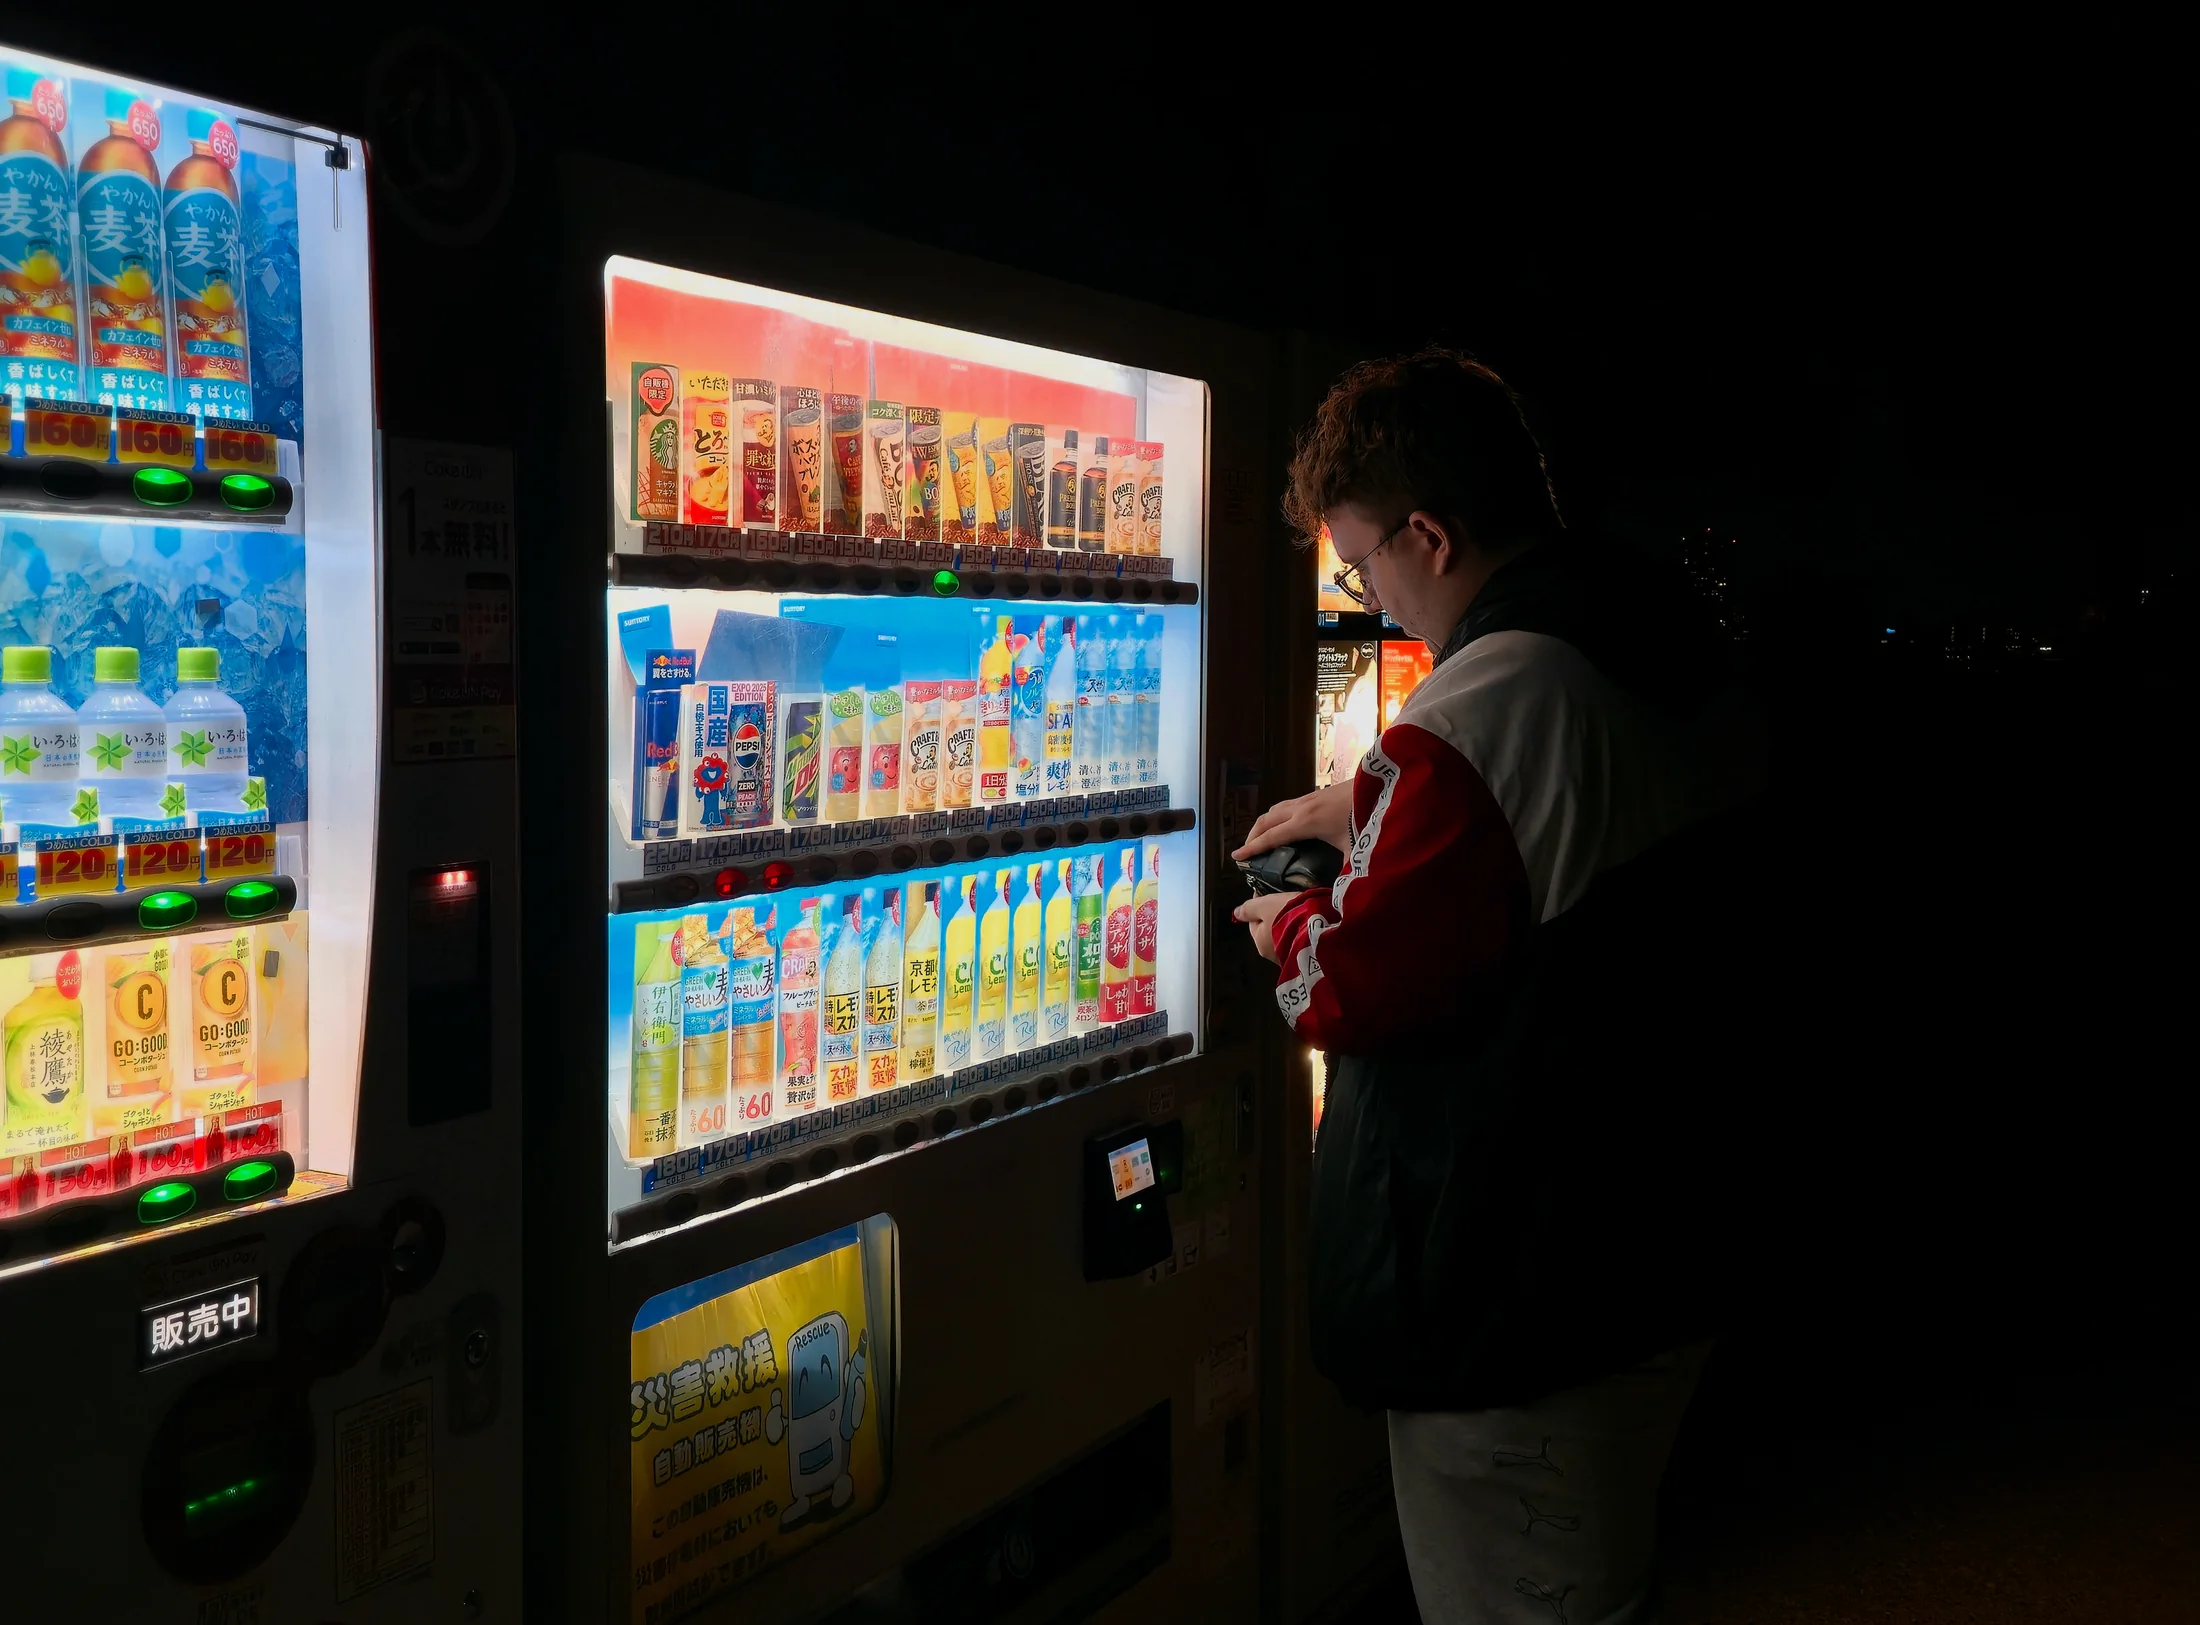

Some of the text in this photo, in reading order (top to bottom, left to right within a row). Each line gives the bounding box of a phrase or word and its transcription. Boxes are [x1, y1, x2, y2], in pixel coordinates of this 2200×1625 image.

[36, 98, 66, 120] 650
[132, 117, 158, 140] 650
[213, 135, 237, 157] 650
[3, 167, 60, 190] やかん
[100, 185, 153, 207] やかん
[0, 187, 70, 246] 麦茶
[185, 203, 231, 224] やかん
[85, 205, 160, 262] 麦茶
[173, 224, 240, 278] 麦茶
[12, 318, 72, 336] カフェインゼロ
[30, 334, 65, 348] ミネラル
[107, 329, 162, 347] カフェインゼロ
[123, 346, 156, 360] ミネラル
[193, 341, 243, 357] カフェインゼロ
[208, 357, 239, 371] ミネラル
[644, 378, 669, 389] 自販機
[648, 389, 666, 400] 限定
[34, 400, 105, 415] つめたい COLD
[125, 409, 189, 425] つめたい COLD
[212, 418, 270, 433] つめたい COLD
[1317, 613, 1325, 626] 01
[1382, 615, 1389, 627] 02
[731, 683, 767, 693] EXPO 2025
[734, 691, 764, 702] EDITION
[706, 686, 729, 748] 国産
[735, 741, 760, 752] PEPSI
[738, 781, 755, 791] ZERO
[133, 829, 196, 844] つめたい COLD
[213, 823, 271, 837] つめたい COLD
[45, 835, 112, 851] つめたい COLD
[733, 967, 750, 977] GREEN
[221, 970, 236, 1006] C
[685, 975, 703, 986] GREEN
[137, 983, 153, 1020] C
[652, 986, 667, 1044] 伊右衛門
[199, 1017, 250, 1042] GO:GOOD
[113, 1033, 168, 1058] GO:GOOD
[204, 1037, 248, 1051] コーンポタージュ
[40, 1028, 67, 1087] 綾鷹
[119, 1053, 166, 1067] コーンポタージュ
[209, 1096, 245, 1111] シャキシャキ
[245, 1105, 263, 1119] HOT
[123, 1114, 162, 1128] シャキシャキ
[155, 1125, 175, 1139] HOT
[65, 1145, 87, 1160] HOT
[715, 1159, 734, 1169] COLD
[666, 1174, 686, 1185] COLD
[151, 1292, 252, 1354] 販売中
[795, 1321, 831, 1353] Rescue
[631, 1327, 779, 1441] 災害救援
[653, 1405, 762, 1487] 自動販売機
